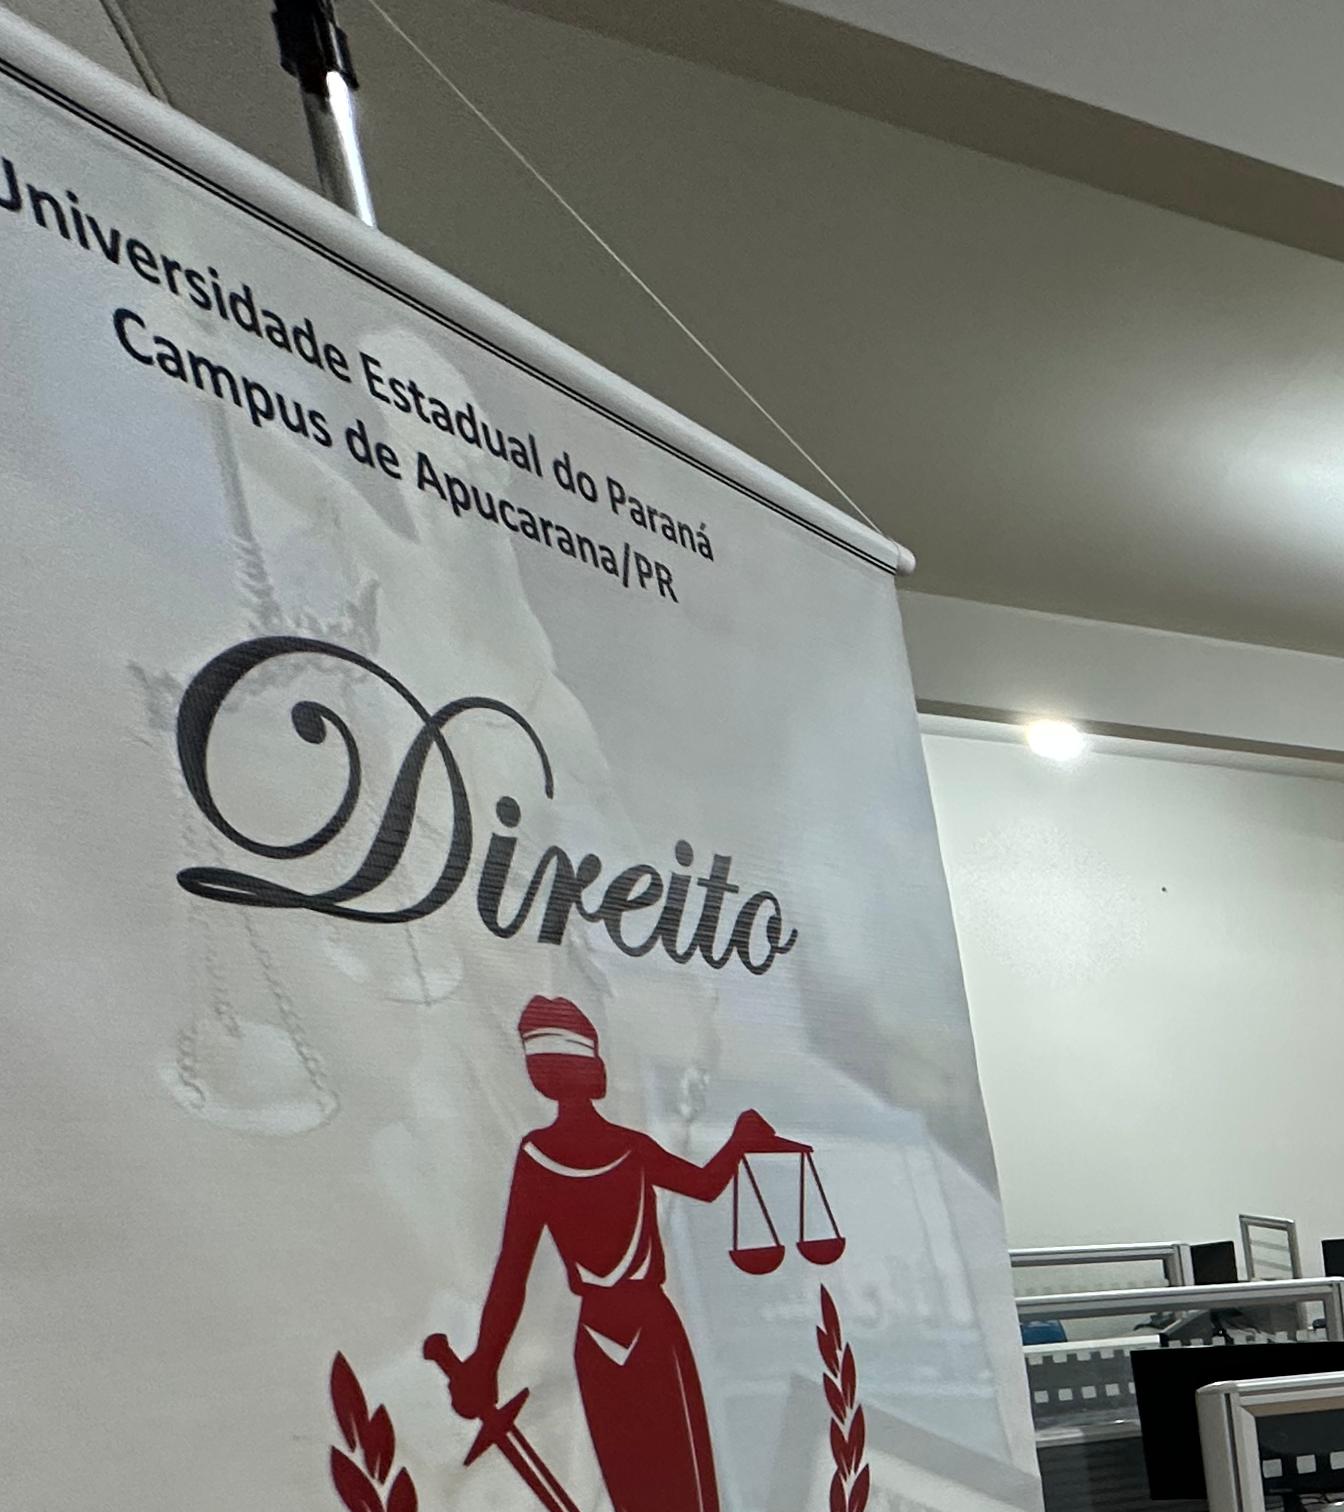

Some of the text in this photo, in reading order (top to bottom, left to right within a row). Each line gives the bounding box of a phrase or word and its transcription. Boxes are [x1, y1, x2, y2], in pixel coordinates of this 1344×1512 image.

[112, 307, 678, 603] Campus de Apucarana/PR
[360, 351, 542, 478] Estadual
[553, 451, 598, 503] do
[606, 475, 714, 562] Paraná
[177, 636, 799, 975] Direito
